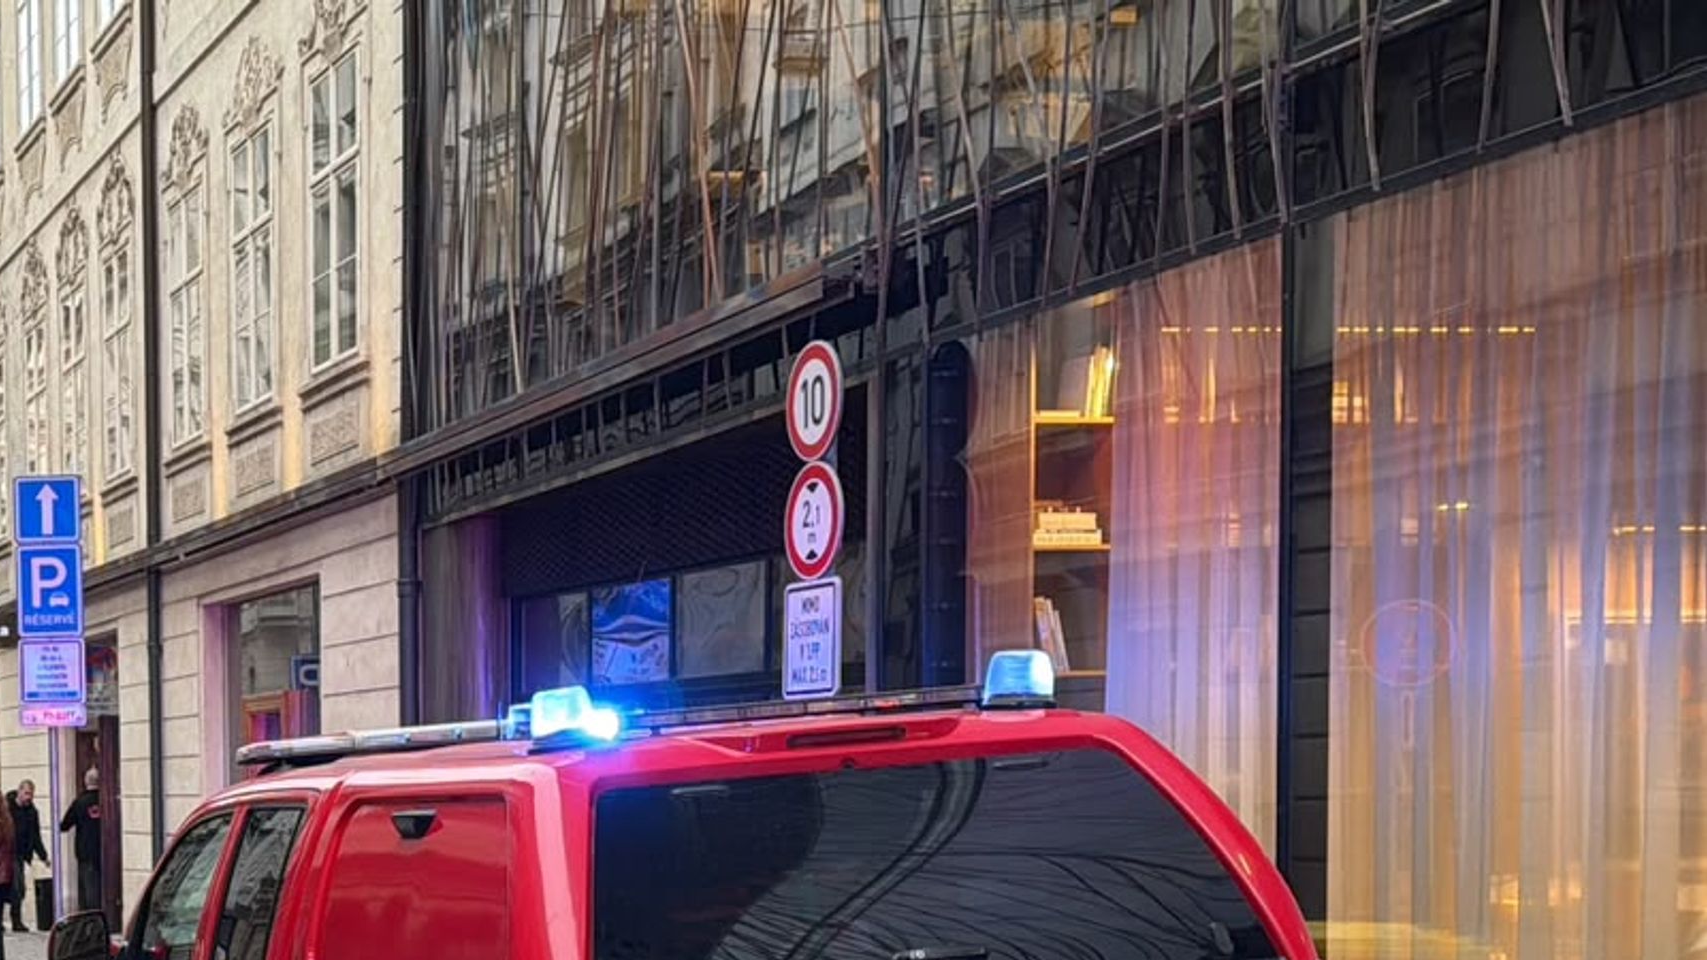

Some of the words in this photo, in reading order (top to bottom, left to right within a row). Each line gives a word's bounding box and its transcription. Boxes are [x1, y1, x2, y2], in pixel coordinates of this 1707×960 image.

[801, 375, 825, 429] 10
[807, 532, 817, 544] m
[31, 556, 67, 608] P
